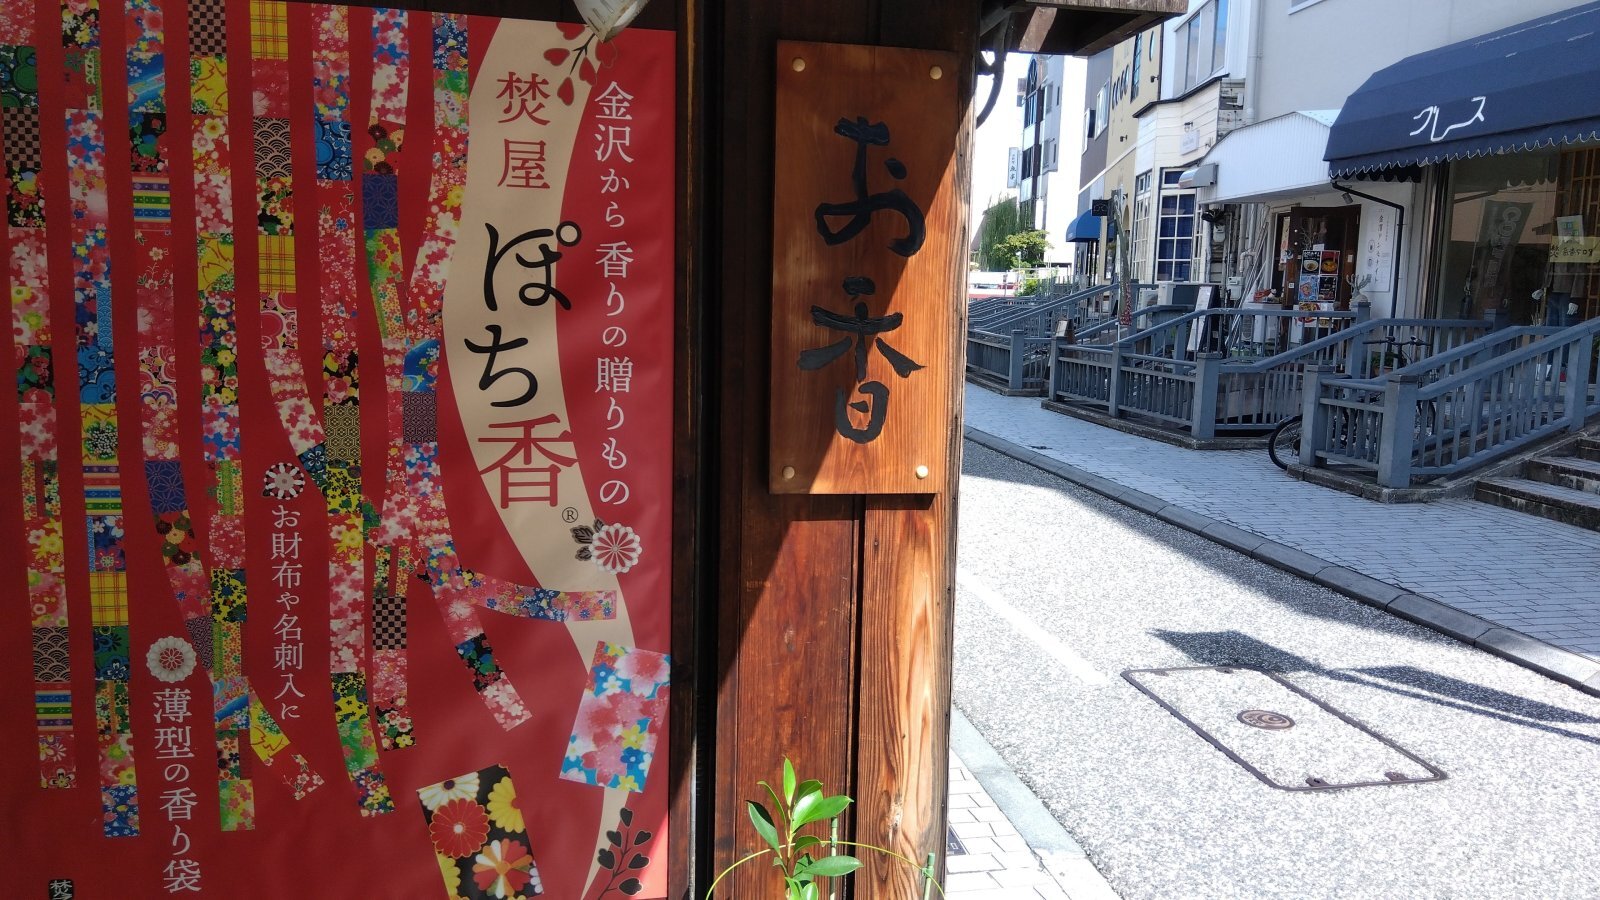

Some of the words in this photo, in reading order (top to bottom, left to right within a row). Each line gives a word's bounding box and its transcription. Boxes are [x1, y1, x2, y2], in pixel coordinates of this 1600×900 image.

[496, 71, 551, 189] 焚屋
[464, 220, 582, 509] ぽち香
[594, 81, 634, 505] 金沢から香りの贈りもの
[797, 115, 927, 444] お香
[271, 504, 305, 721] お財布や名刺入に
[153, 688, 202, 893] 薄型の香り袋
